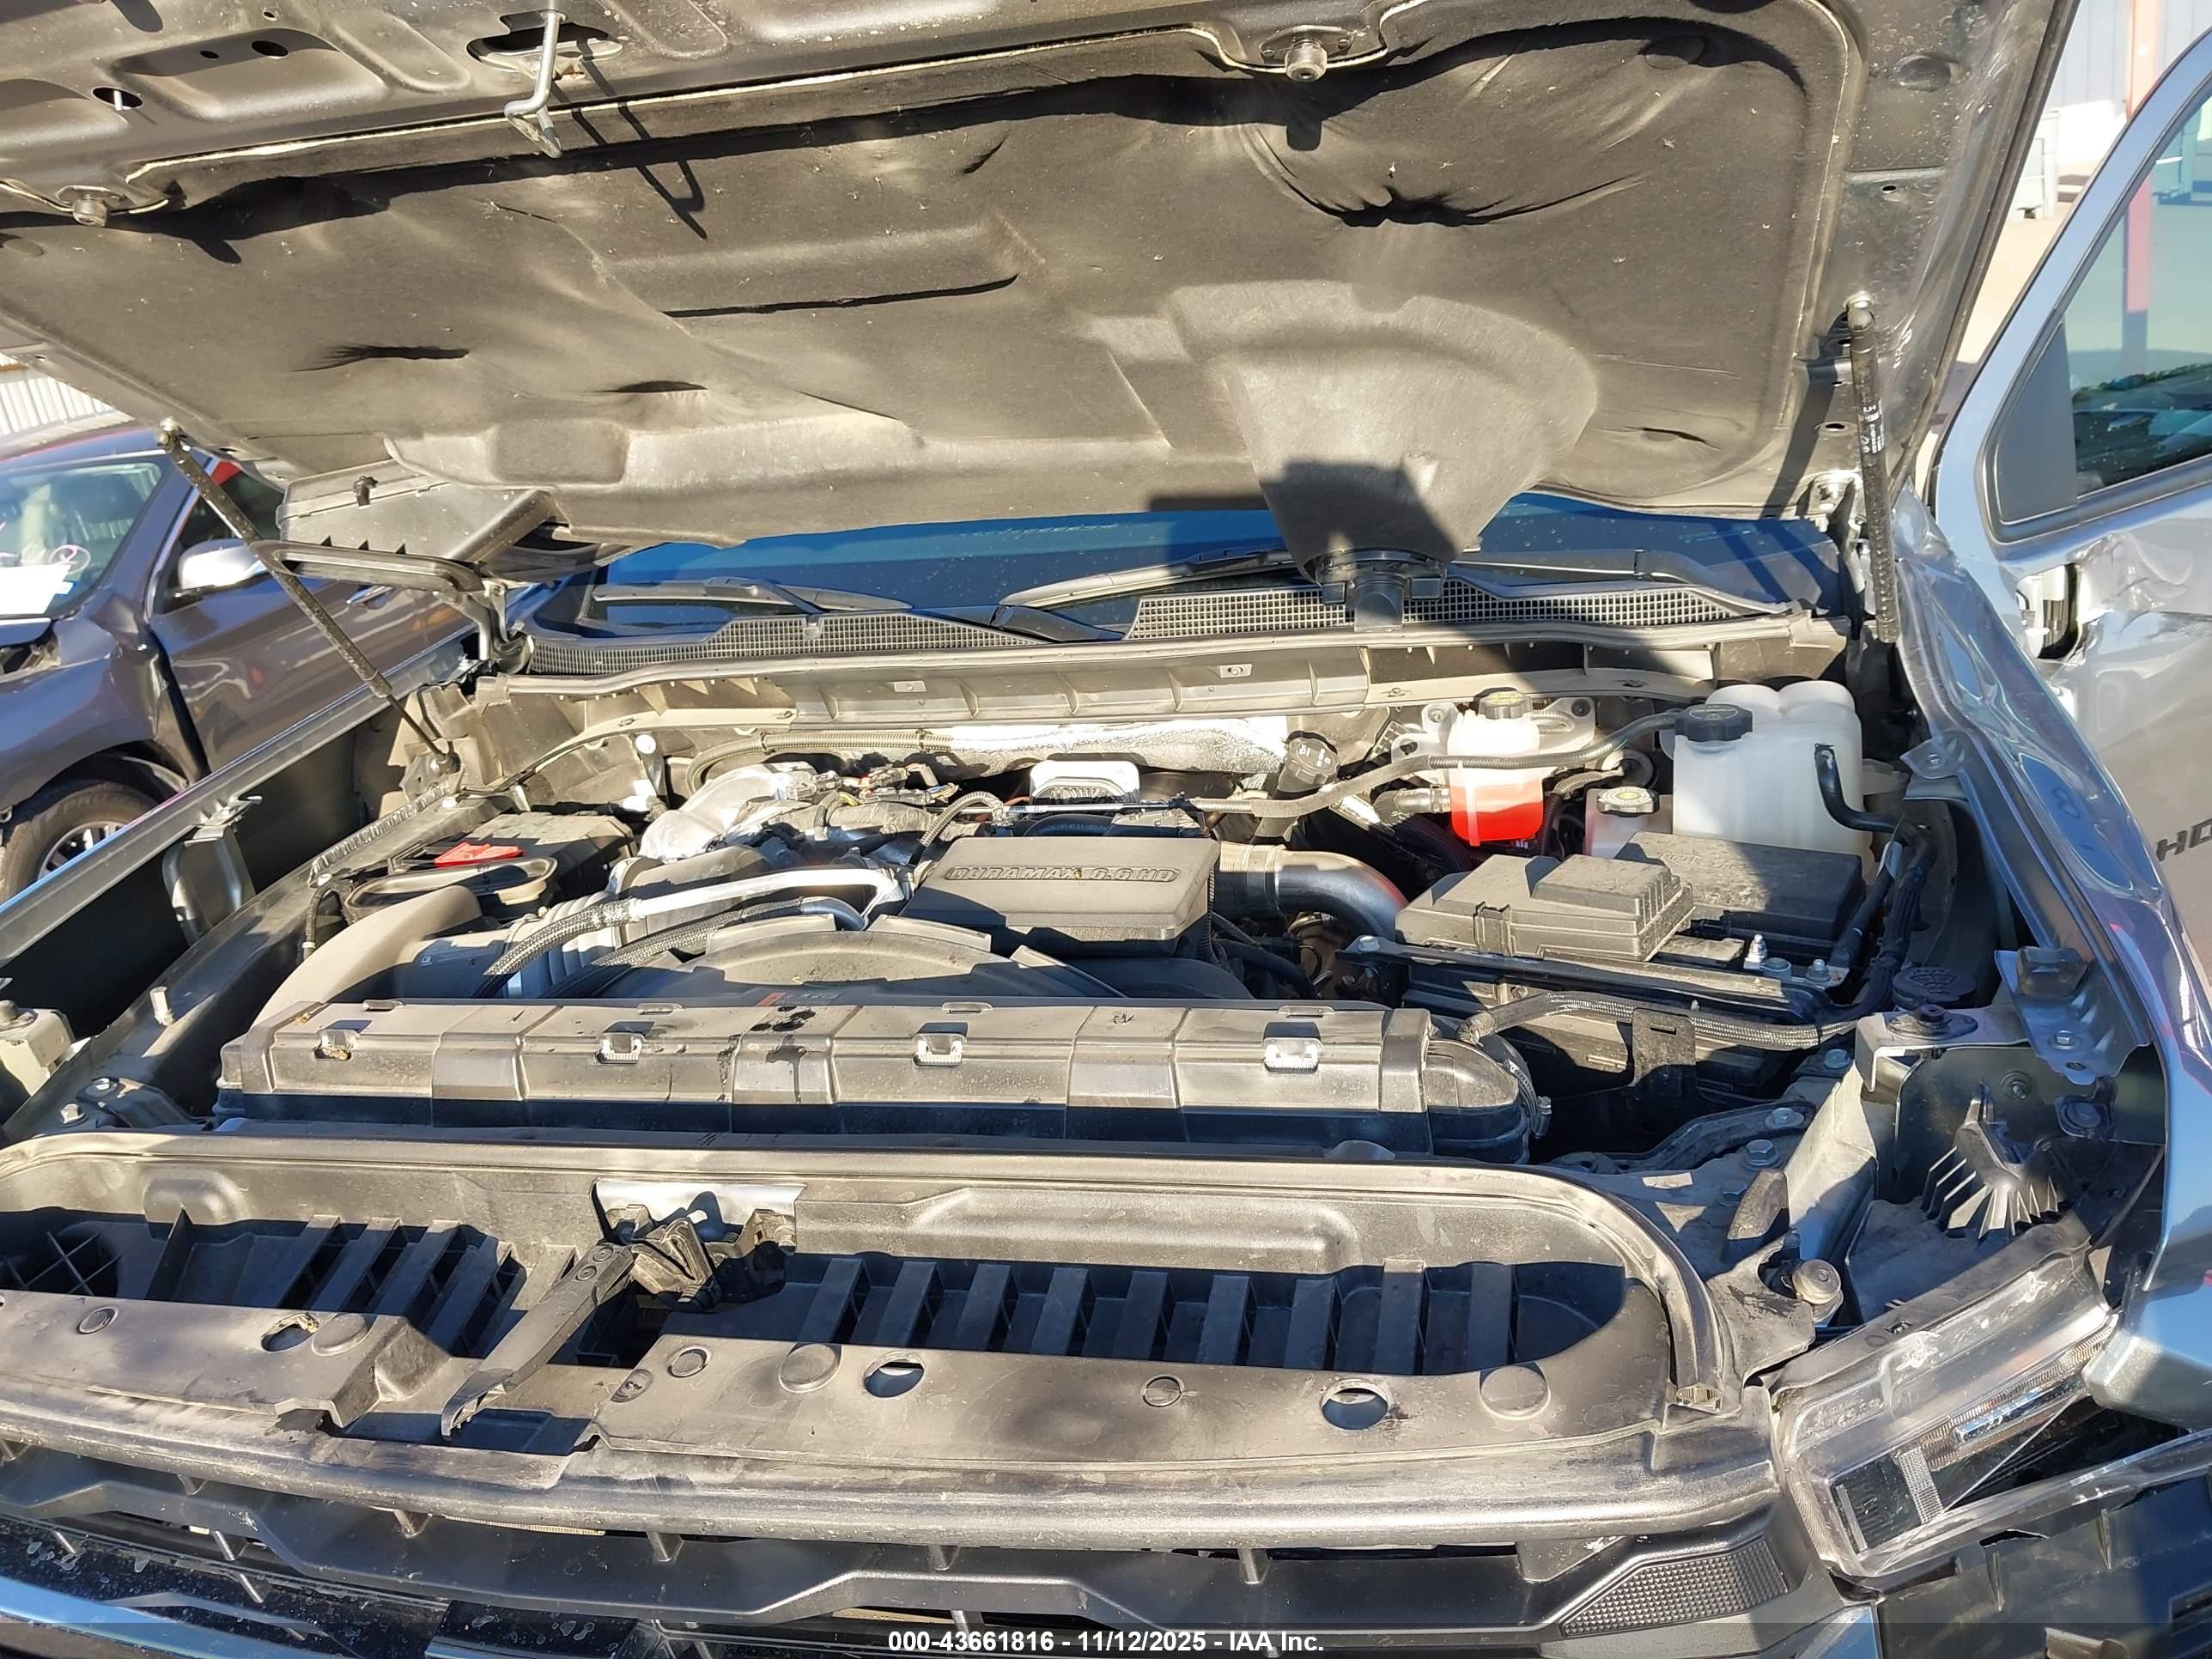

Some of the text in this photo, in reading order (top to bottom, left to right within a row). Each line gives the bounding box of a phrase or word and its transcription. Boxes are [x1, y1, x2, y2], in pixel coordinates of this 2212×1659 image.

[2155, 817, 2212, 862] HD
[947, 866, 1178, 882] DURAMAX 6.6 HD
